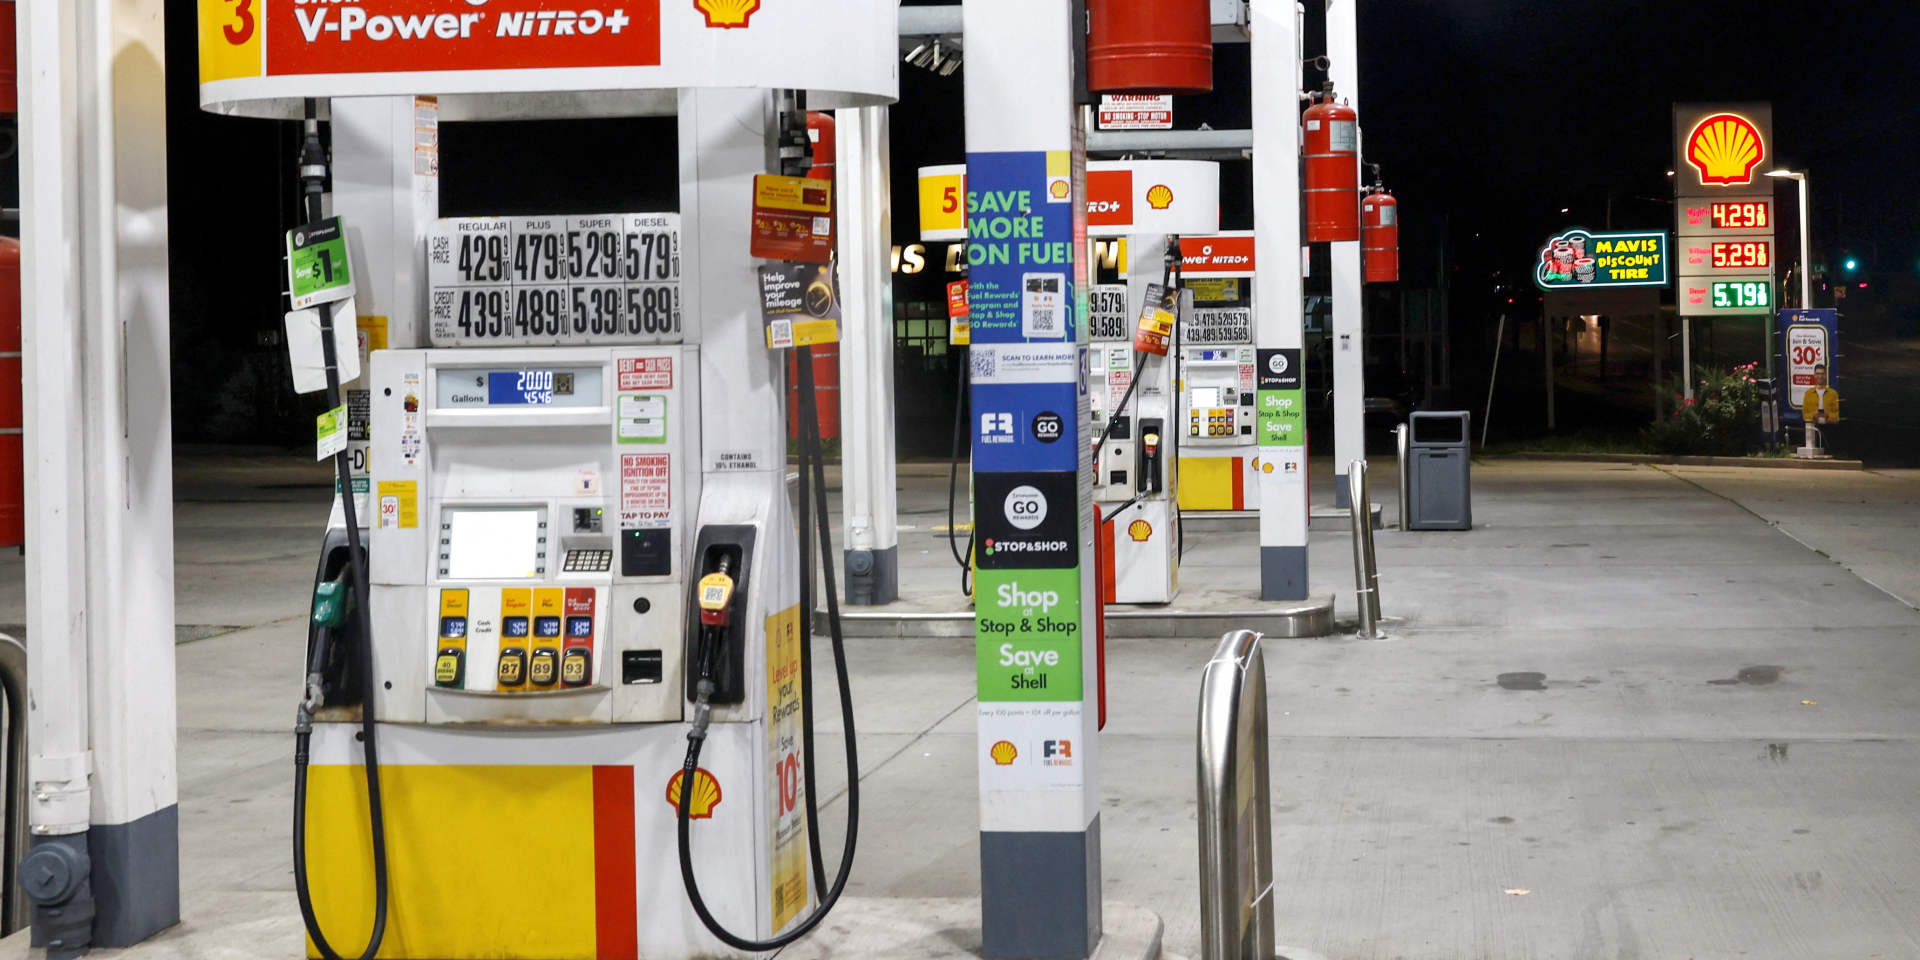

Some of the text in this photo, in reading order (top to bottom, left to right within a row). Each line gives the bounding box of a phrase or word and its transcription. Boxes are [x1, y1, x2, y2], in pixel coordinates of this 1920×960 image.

[223, 0, 254, 46] 3
[942, 187, 958, 213] 5
[967, 190, 1030, 213] SAVE
[1687, 204, 1755, 226] Regular 4.29
[1687, 217, 1703, 225] Cash
[458, 218, 669, 231] REGULAR PLUS SUPER DIESEL
[968, 216, 1044, 239] MORE
[433, 236, 449, 250] CASH
[1596, 239, 1657, 253] MAVIS
[433, 250, 450, 263] PRICE
[459, 235, 502, 282] 429
[514, 232, 558, 281] 479
[568, 231, 616, 278] 529
[626, 231, 670, 280] 579
[968, 243, 1010, 266] ON
[1019, 242, 1074, 264] FUEL
[1598, 254, 1660, 268] DISCOUNT
[1688, 257, 1703, 265] Cash
[1714, 244, 1756, 266] 5.29
[296, 267, 312, 278] Save
[763, 272, 785, 282] Help
[1609, 268, 1649, 279] TIRE
[764, 281, 800, 291] improve
[434, 291, 454, 305] CREDIT
[765, 291, 786, 300] your
[1688, 283, 1756, 306] Diesel 5.79
[766, 298, 802, 308] mileage
[1101, 292, 1121, 313] 579
[434, 306, 451, 319] PRICE
[458, 291, 502, 338] 439
[515, 289, 559, 336] 489
[572, 287, 617, 334] 539
[627, 286, 671, 334] 589
[996, 311, 1015, 320] Shop
[1202, 313, 1215, 326] 479
[1234, 313, 1247, 326] 579
[1102, 317, 1121, 337] 589
[1187, 327, 1247, 342] 439 489 539 589
[620, 359, 635, 372] DEBIT
[645, 359, 656, 372] CASH
[476, 371, 552, 390] $ 20.00
[452, 395, 484, 403] Gallons
[1266, 395, 1292, 408] Shop
[1258, 410, 1273, 419] Stop
[1283, 410, 1300, 418] Shop
[1038, 422, 1058, 432] GO
[1266, 421, 1292, 432] Save
[982, 435, 992, 443] FUEL
[624, 456, 667, 466] NO SMOKING
[624, 467, 667, 477] IGNITION OFF
[1013, 501, 1038, 514] GO
[997, 582, 1058, 613] Shop
[1023, 608, 1033, 616] at
[980, 617, 1077, 636] Stop & Shop
[1000, 643, 1059, 667] Save
[502, 665, 518, 673] 87
[534, 665, 550, 673] 89
[566, 664, 582, 673] 93
[772, 657, 798, 684] Level up
[1024, 666, 1034, 675] at
[1011, 674, 1047, 689] Shell
[778, 680, 793, 706] your
[773, 692, 799, 725] Rewards
[781, 735, 793, 752] Save
